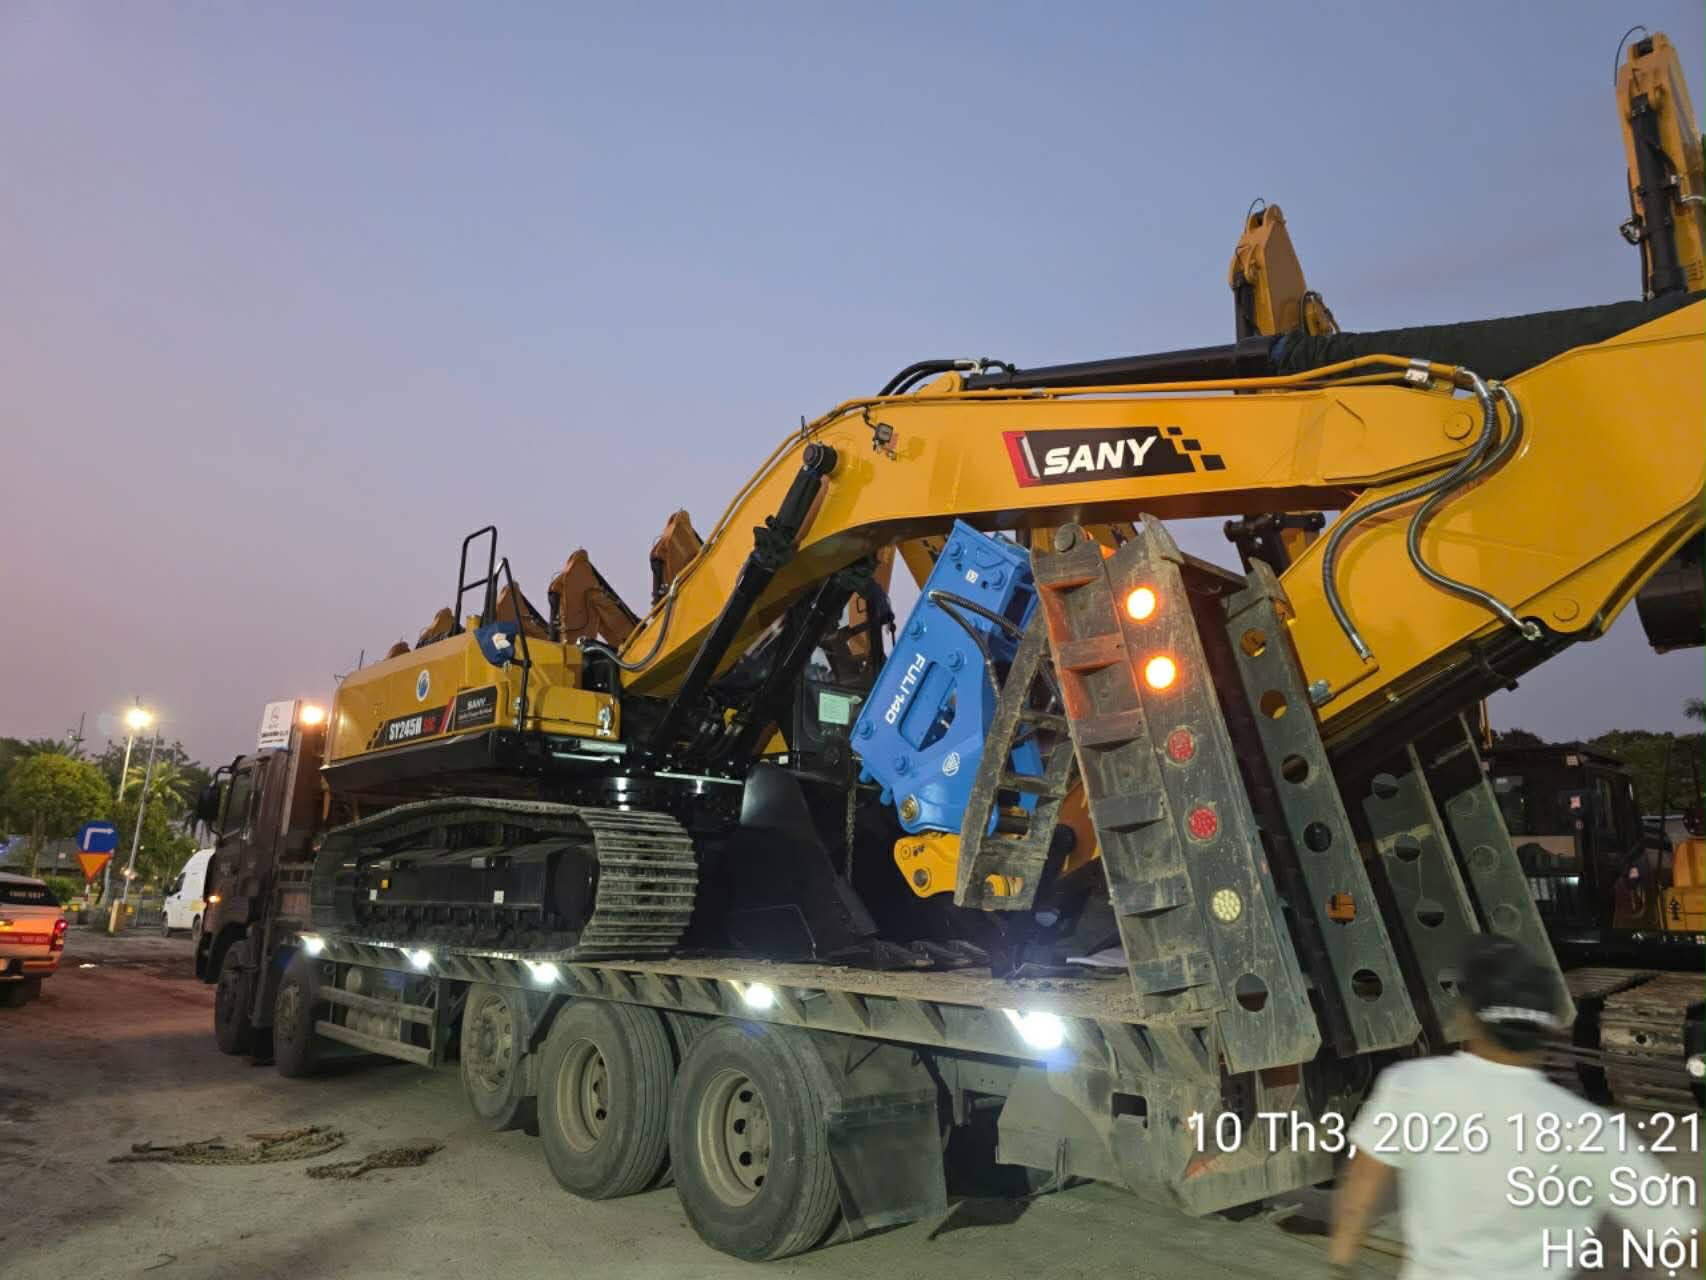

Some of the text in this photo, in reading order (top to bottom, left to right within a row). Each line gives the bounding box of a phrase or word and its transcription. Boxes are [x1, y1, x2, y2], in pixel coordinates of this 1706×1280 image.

[1043, 435, 1158, 476] SANY
[884, 653, 926, 725] FULI 140
